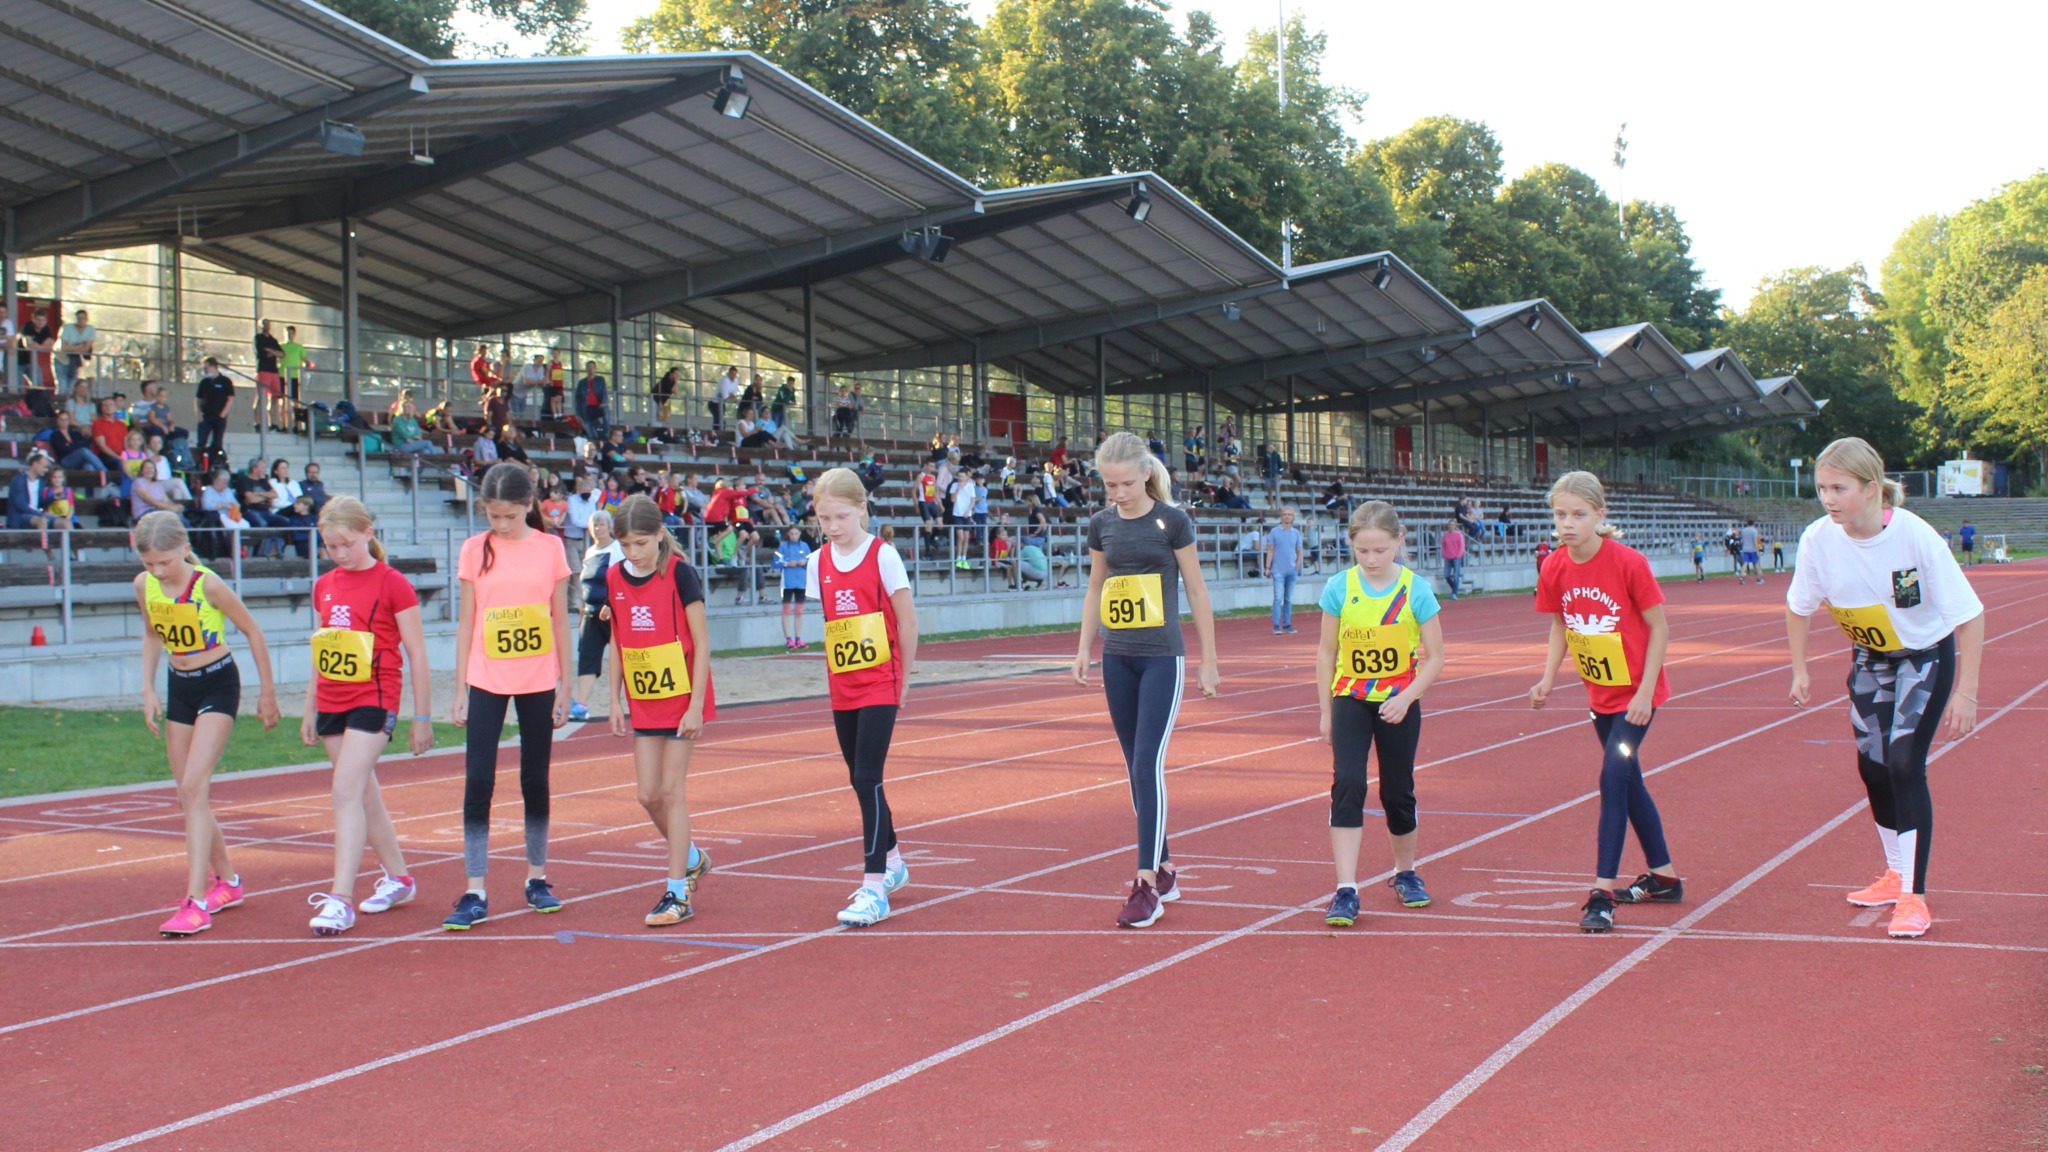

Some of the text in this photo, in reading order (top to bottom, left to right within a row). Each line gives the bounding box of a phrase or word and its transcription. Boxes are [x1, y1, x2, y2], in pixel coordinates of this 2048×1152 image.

[1109, 598, 1146, 624] 591
[1573, 587, 1621, 615] PHÖNIX
[154, 623, 196, 648] 640
[497, 626, 542, 653] 585
[1840, 621, 1886, 648] 590
[319, 649, 358, 677] 625
[834, 637, 877, 668] 626
[1351, 647, 1399, 674] 639
[1578, 653, 1613, 681] 561
[633, 667, 676, 695] 624
